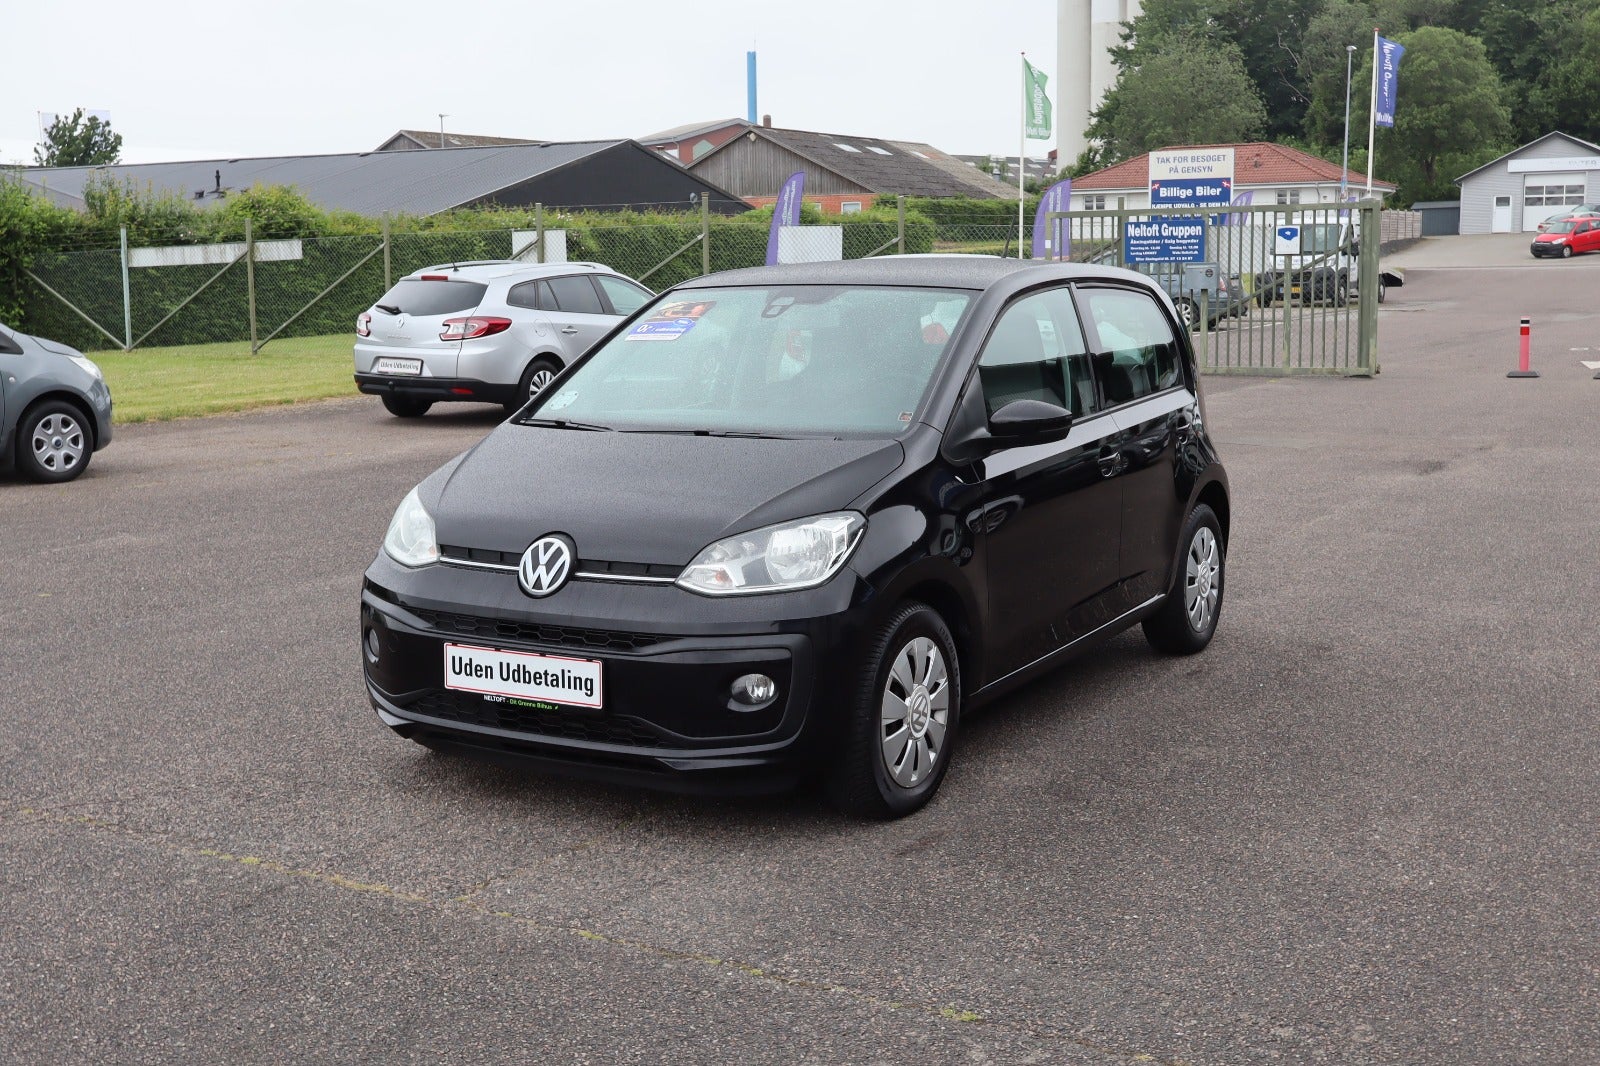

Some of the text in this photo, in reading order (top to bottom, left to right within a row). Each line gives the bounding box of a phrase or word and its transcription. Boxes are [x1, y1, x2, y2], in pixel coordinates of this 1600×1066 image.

[1156, 156, 1171, 164] TAK
[1191, 154, 1227, 163] BESØGET
[1169, 165, 1213, 174] PÅ GENSYN
[1159, 186, 1222, 198] Billige Biler
[1127, 223, 1202, 238] Neltoft Gruppen
[451, 655, 595, 698] Uden Udbetaling
[483, 694, 506, 703] NELTOFT
